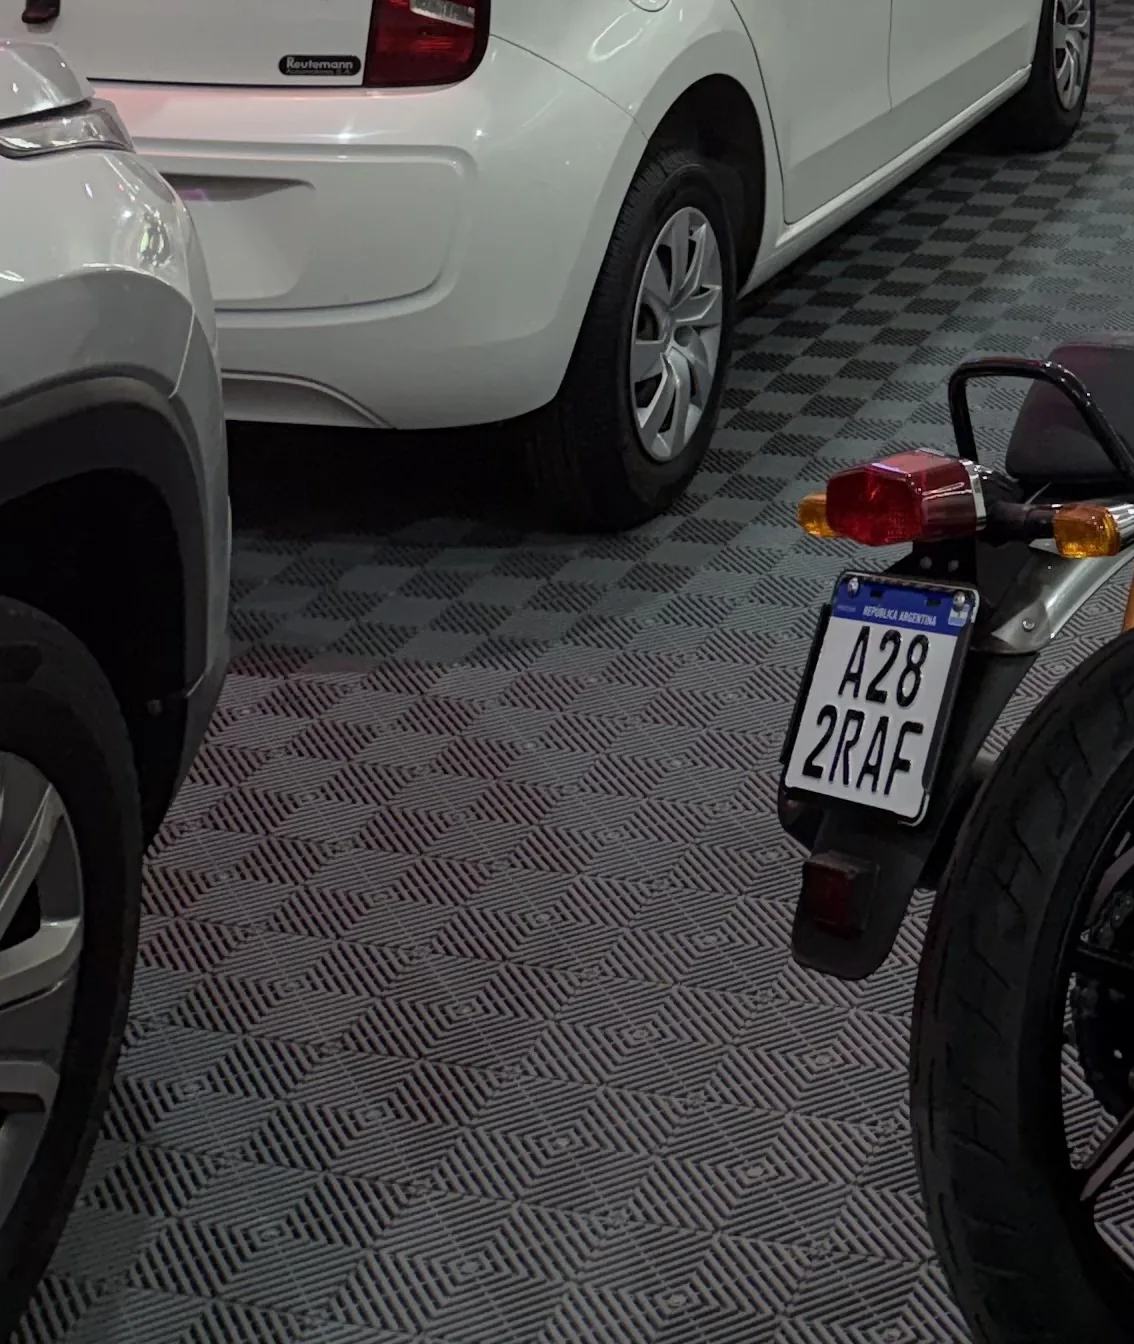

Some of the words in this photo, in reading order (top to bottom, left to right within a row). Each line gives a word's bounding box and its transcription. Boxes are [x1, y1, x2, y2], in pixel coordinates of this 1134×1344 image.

[285, 56, 354, 69] Reutemann
[862, 603, 898, 622] REPÚBLICA
[898, 611, 937, 627] ARGENTINA
[837, 625, 930, 708] A28
[801, 704, 924, 796] 2RAF
